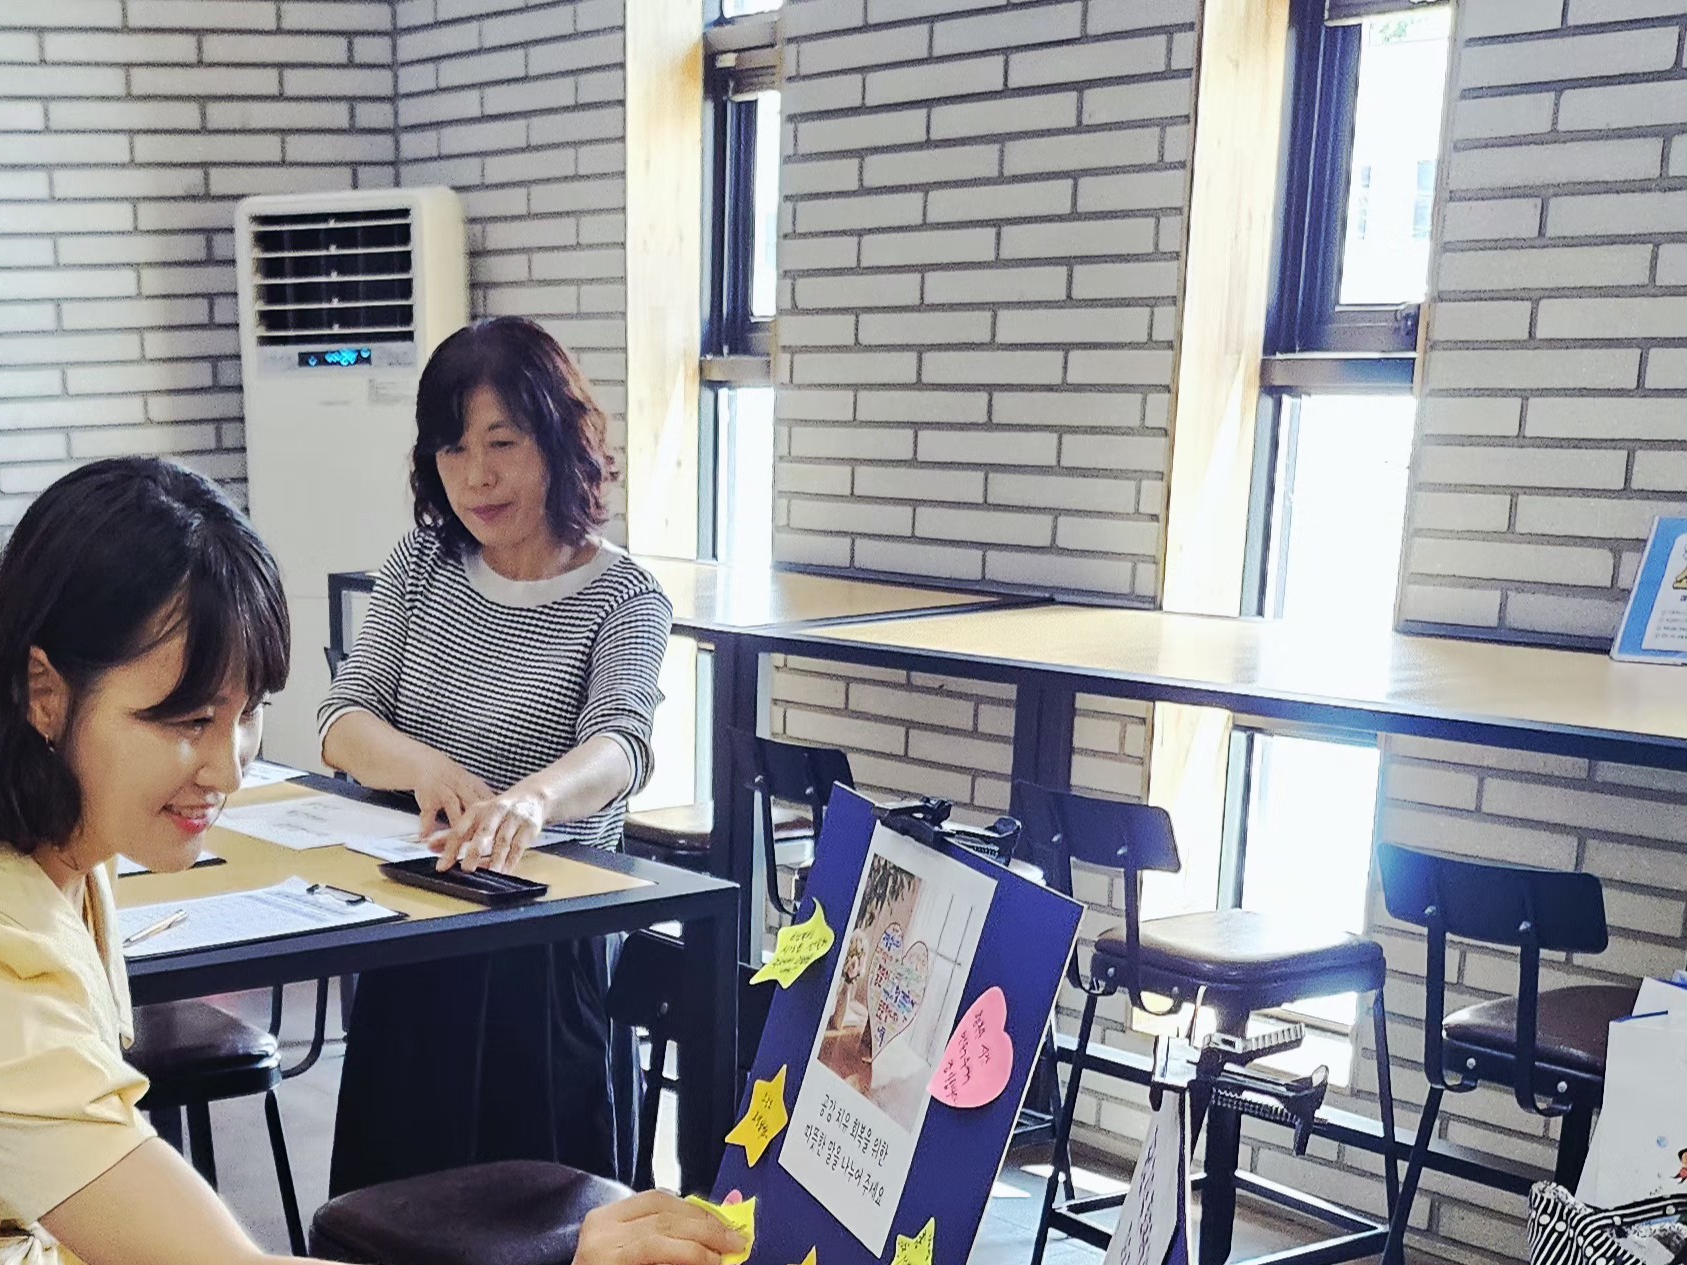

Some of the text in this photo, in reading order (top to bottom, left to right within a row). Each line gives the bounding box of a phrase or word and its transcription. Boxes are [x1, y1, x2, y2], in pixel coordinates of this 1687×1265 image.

[804, 1124, 885, 1207] 따뜻한 말을 나누어 주세요
[819, 1093, 889, 1168] 공감 치유 회복을 위한
